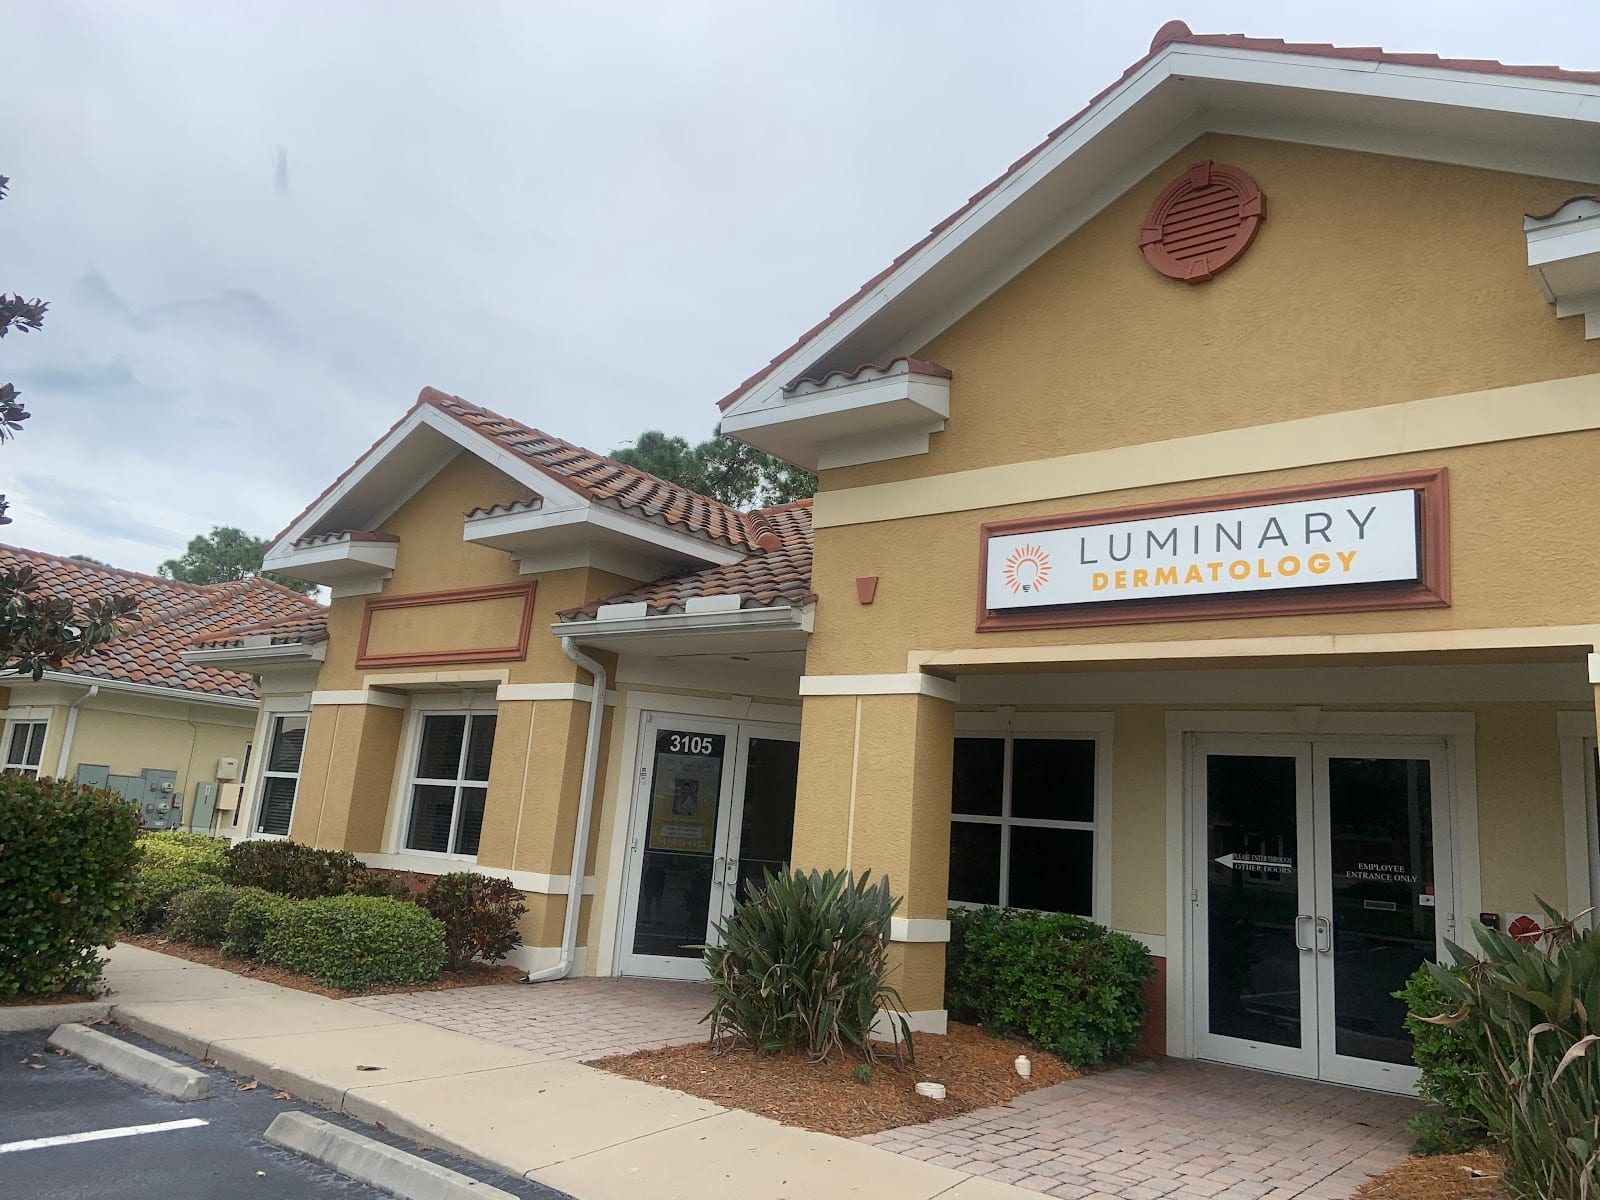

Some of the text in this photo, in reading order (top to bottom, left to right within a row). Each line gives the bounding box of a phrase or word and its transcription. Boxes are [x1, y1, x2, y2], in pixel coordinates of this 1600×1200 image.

[1079, 507, 1377, 565] LUMINARY
[1092, 550, 1358, 591] DERMATOLOGY
[670, 734, 712, 755] 3105
[1235, 864, 1292, 874] OTHER DOORS
[1358, 863, 1405, 873] EMPLOYEE
[1346, 871, 1418, 883] ENTRANCE ONLY
